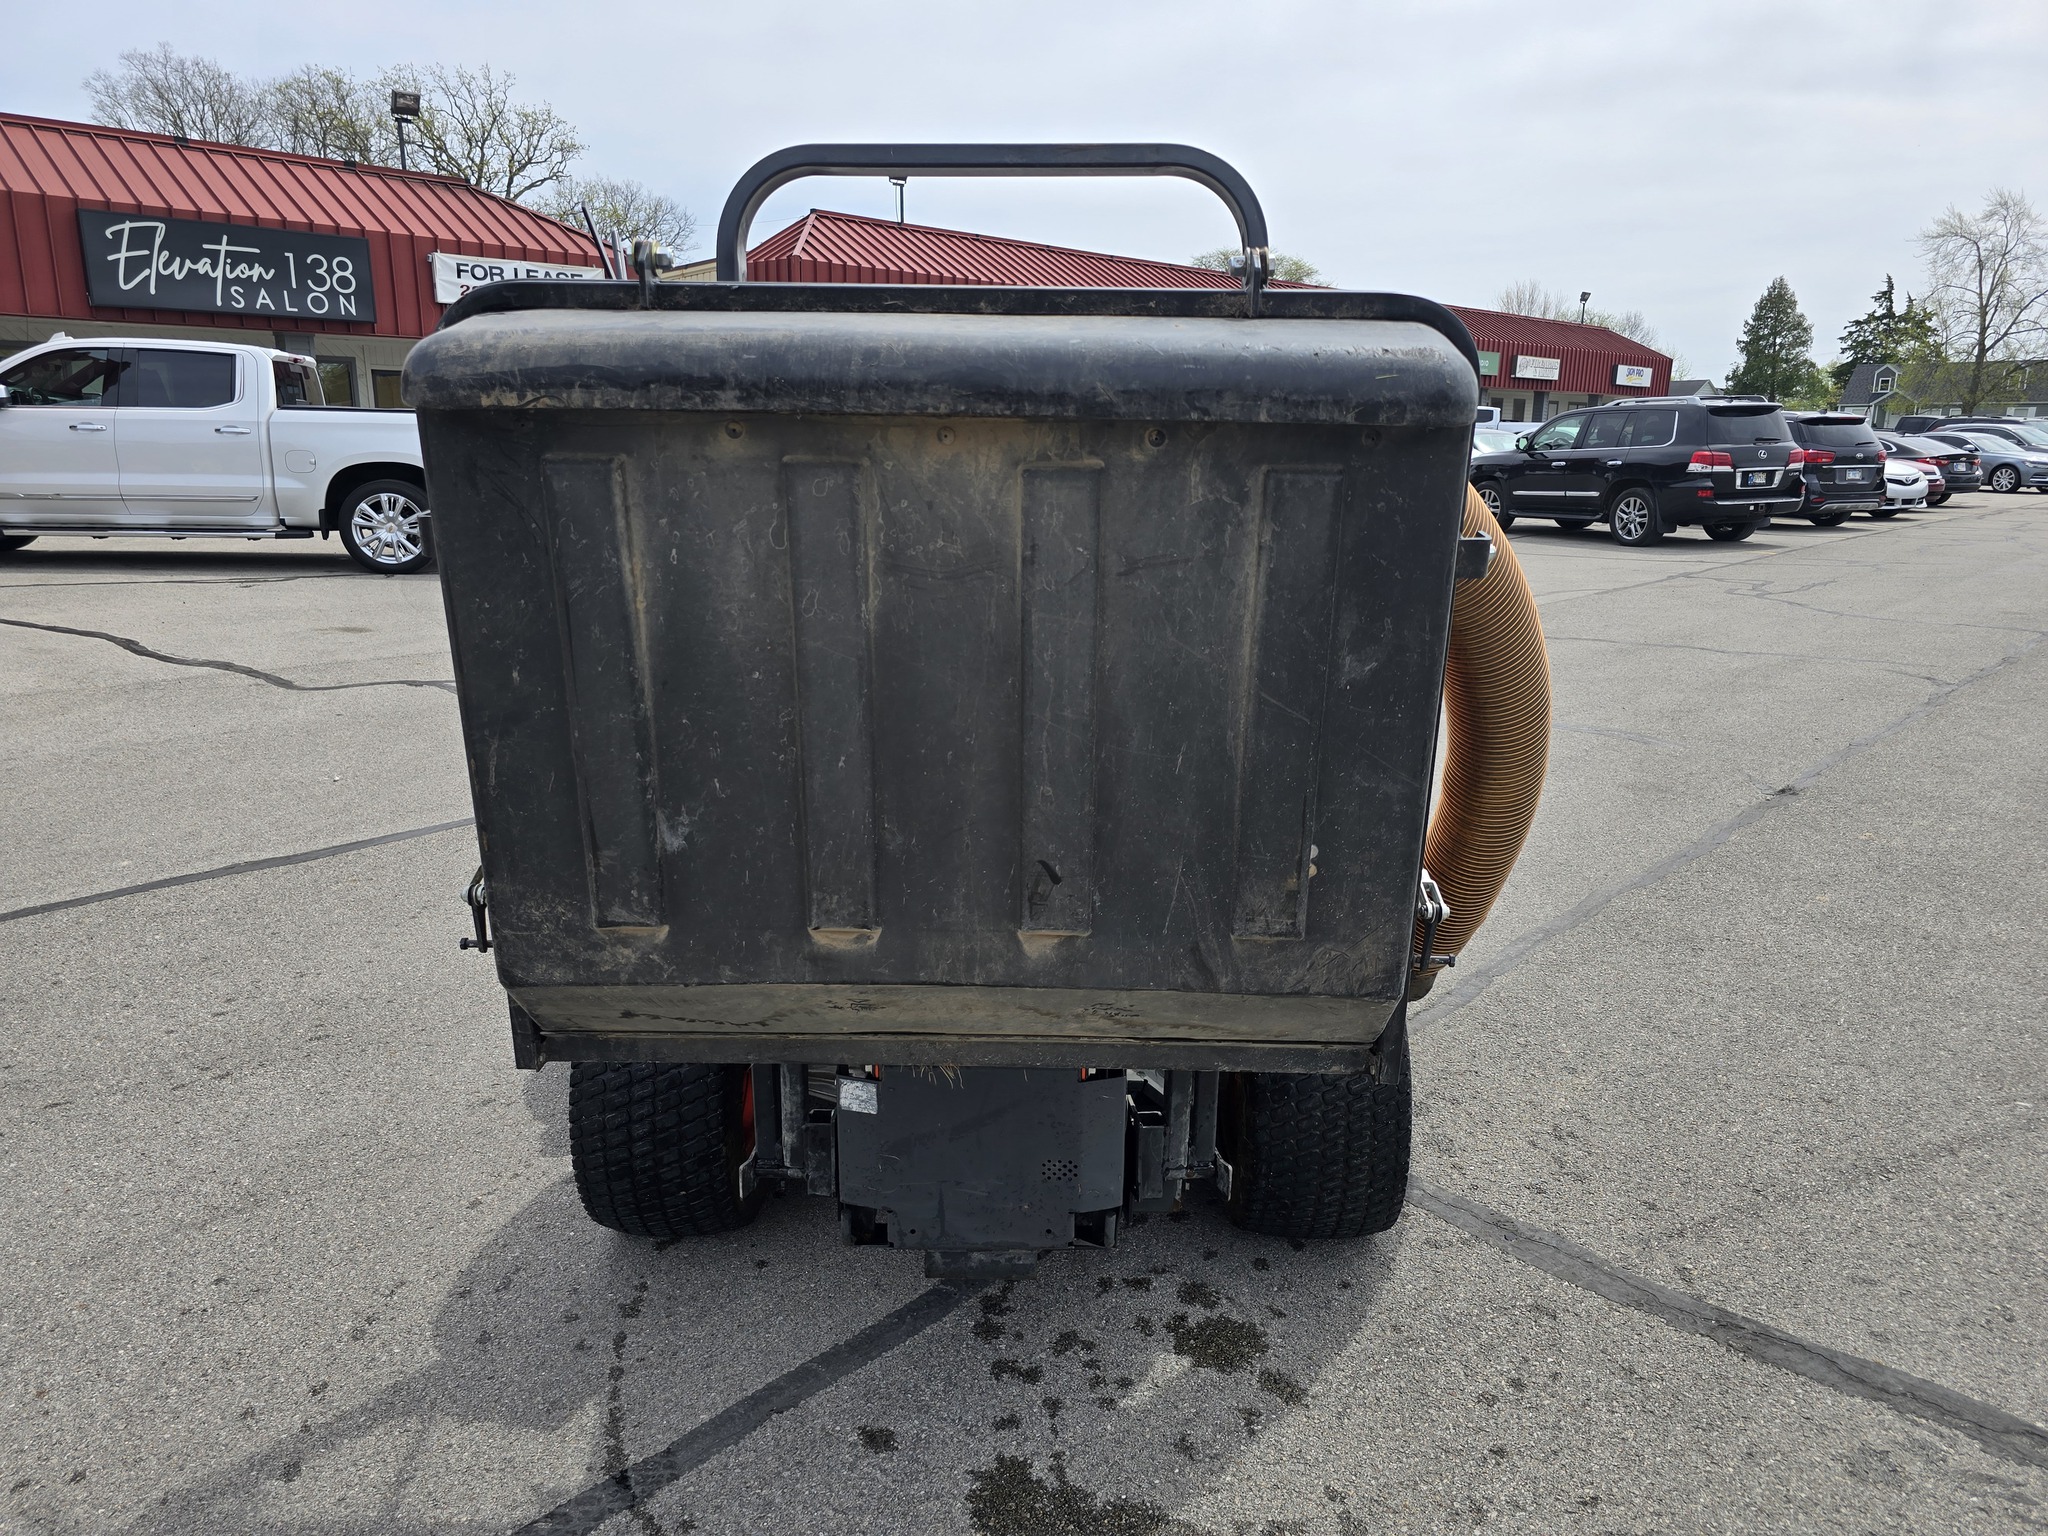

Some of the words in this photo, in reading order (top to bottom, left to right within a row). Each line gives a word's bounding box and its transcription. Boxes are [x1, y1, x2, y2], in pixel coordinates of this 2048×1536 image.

[105, 220, 276, 307] Elevation
[284, 252, 357, 294] 138
[455, 262, 505, 282] FOR
[230, 285, 357, 317] SALON
